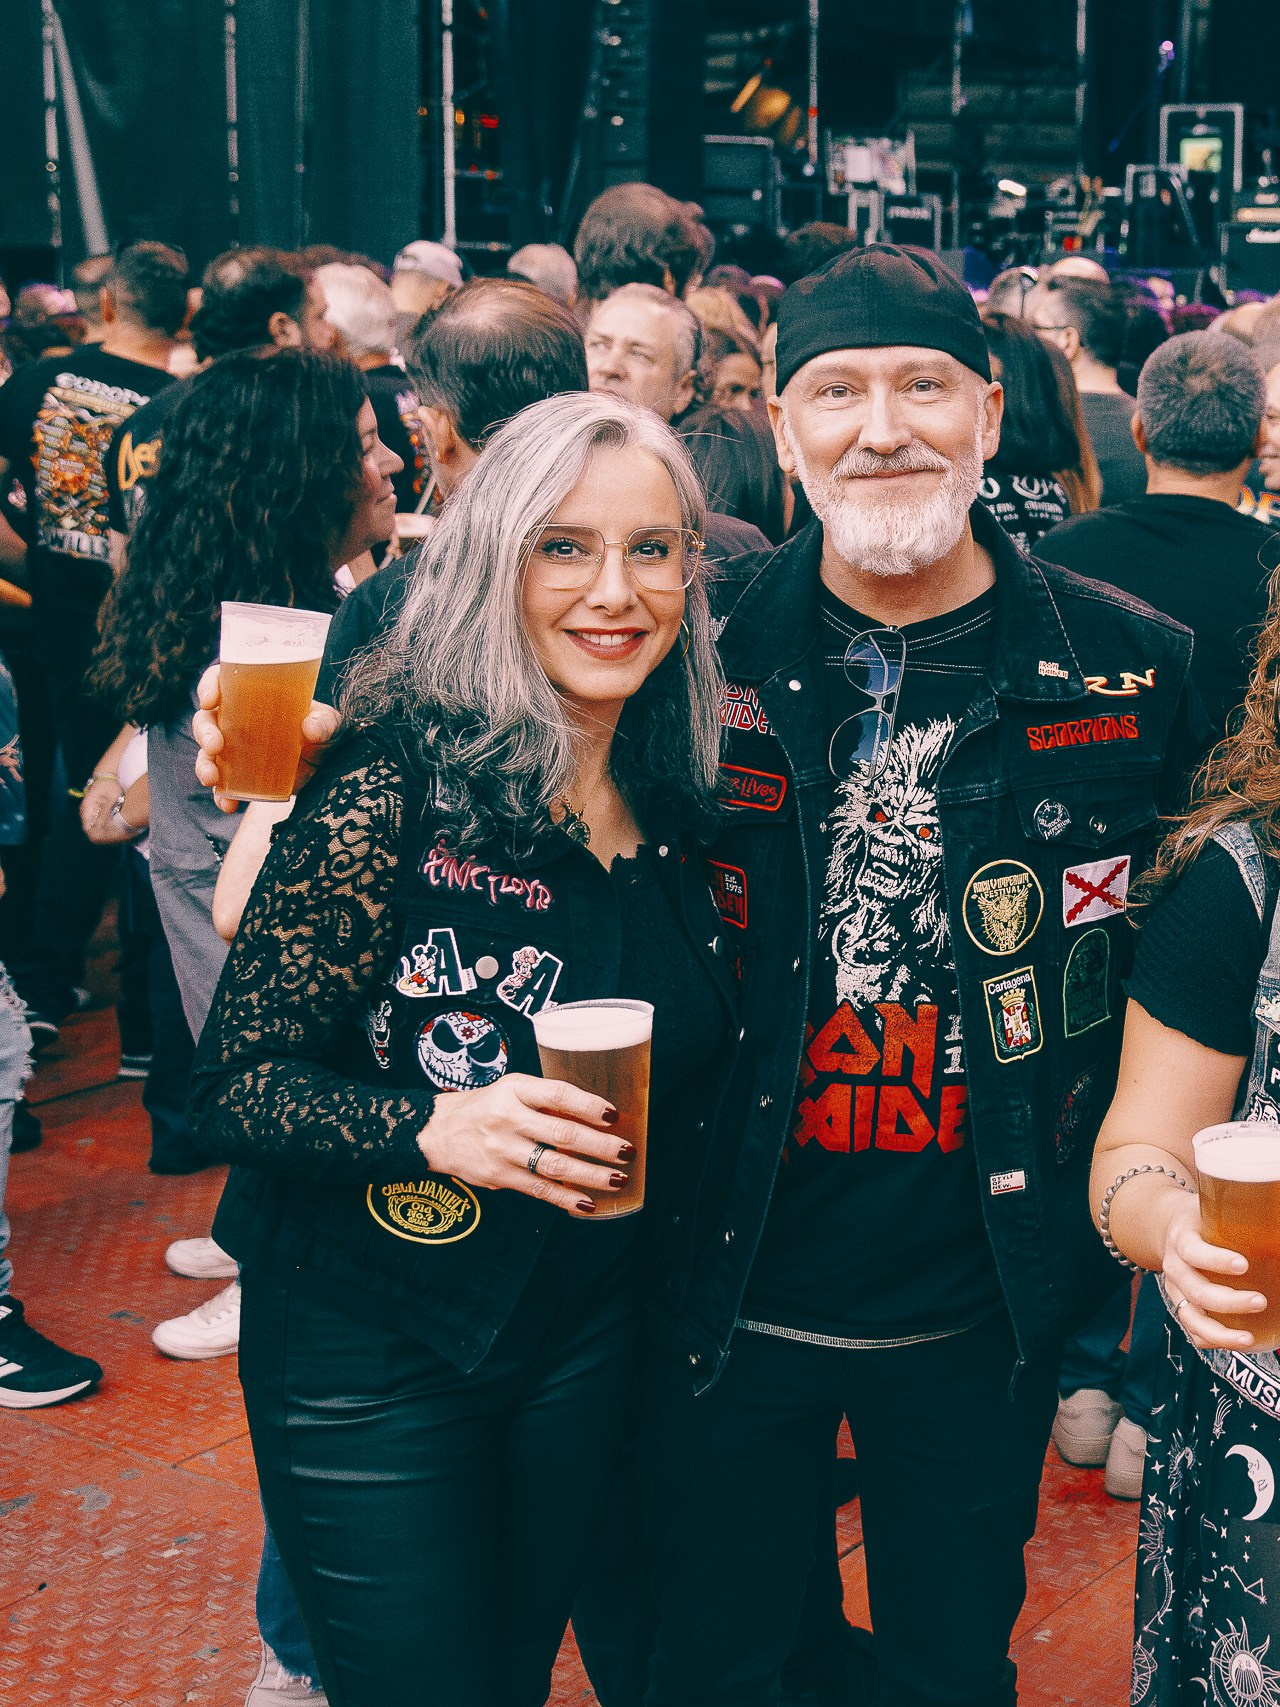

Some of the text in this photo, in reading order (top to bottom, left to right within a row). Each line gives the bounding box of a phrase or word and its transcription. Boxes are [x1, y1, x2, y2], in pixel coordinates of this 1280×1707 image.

[1084, 668, 1157, 696] RN
[1026, 714, 1140, 751] SCORPIONS
[423, 848, 553, 911] PINK FLOYD
[984, 884, 1022, 899] FESTIVAL
[987, 973, 1032, 995] Cartagena
[411, 1201, 433, 1214] Old
[417, 1180, 472, 1217] DANIEL'S
